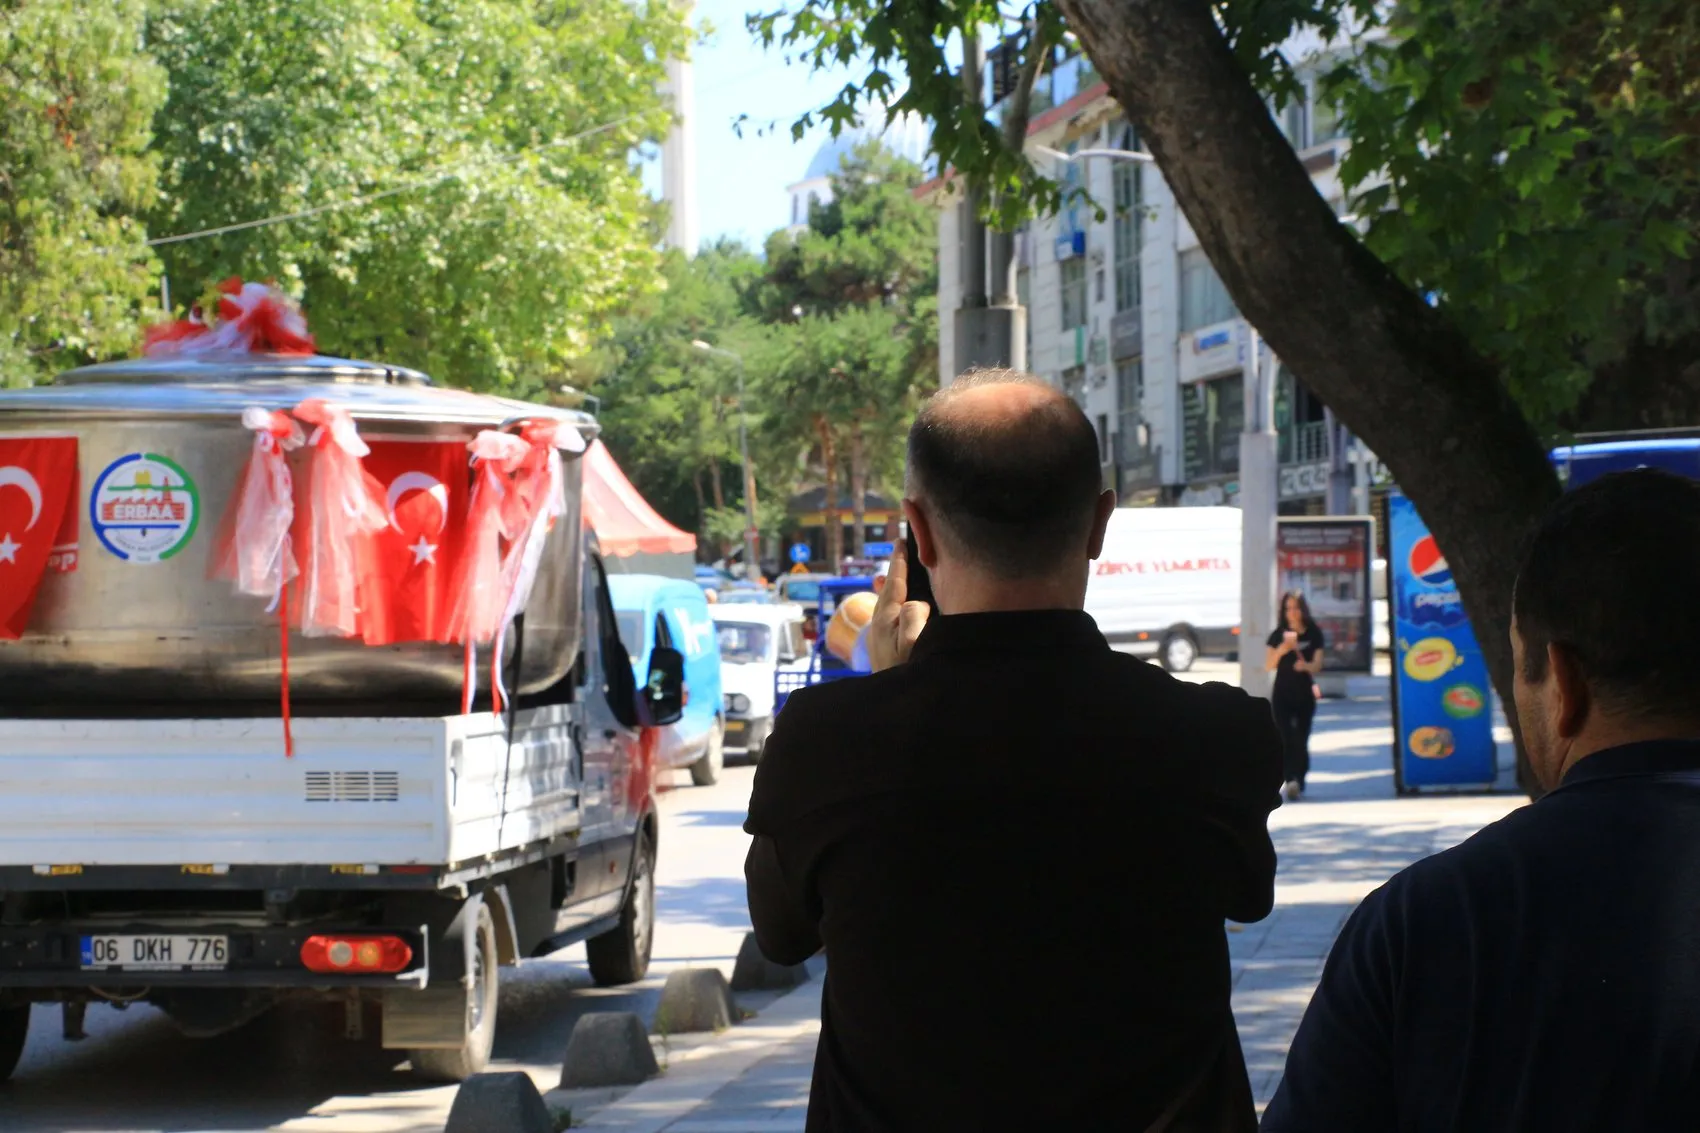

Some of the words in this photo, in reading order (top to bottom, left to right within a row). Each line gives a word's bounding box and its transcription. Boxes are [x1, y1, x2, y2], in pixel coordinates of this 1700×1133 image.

[114, 504, 175, 520] ERBAA
[94, 939, 118, 961] 06
[133, 938, 172, 961] DKH
[187, 938, 225, 961] 776
